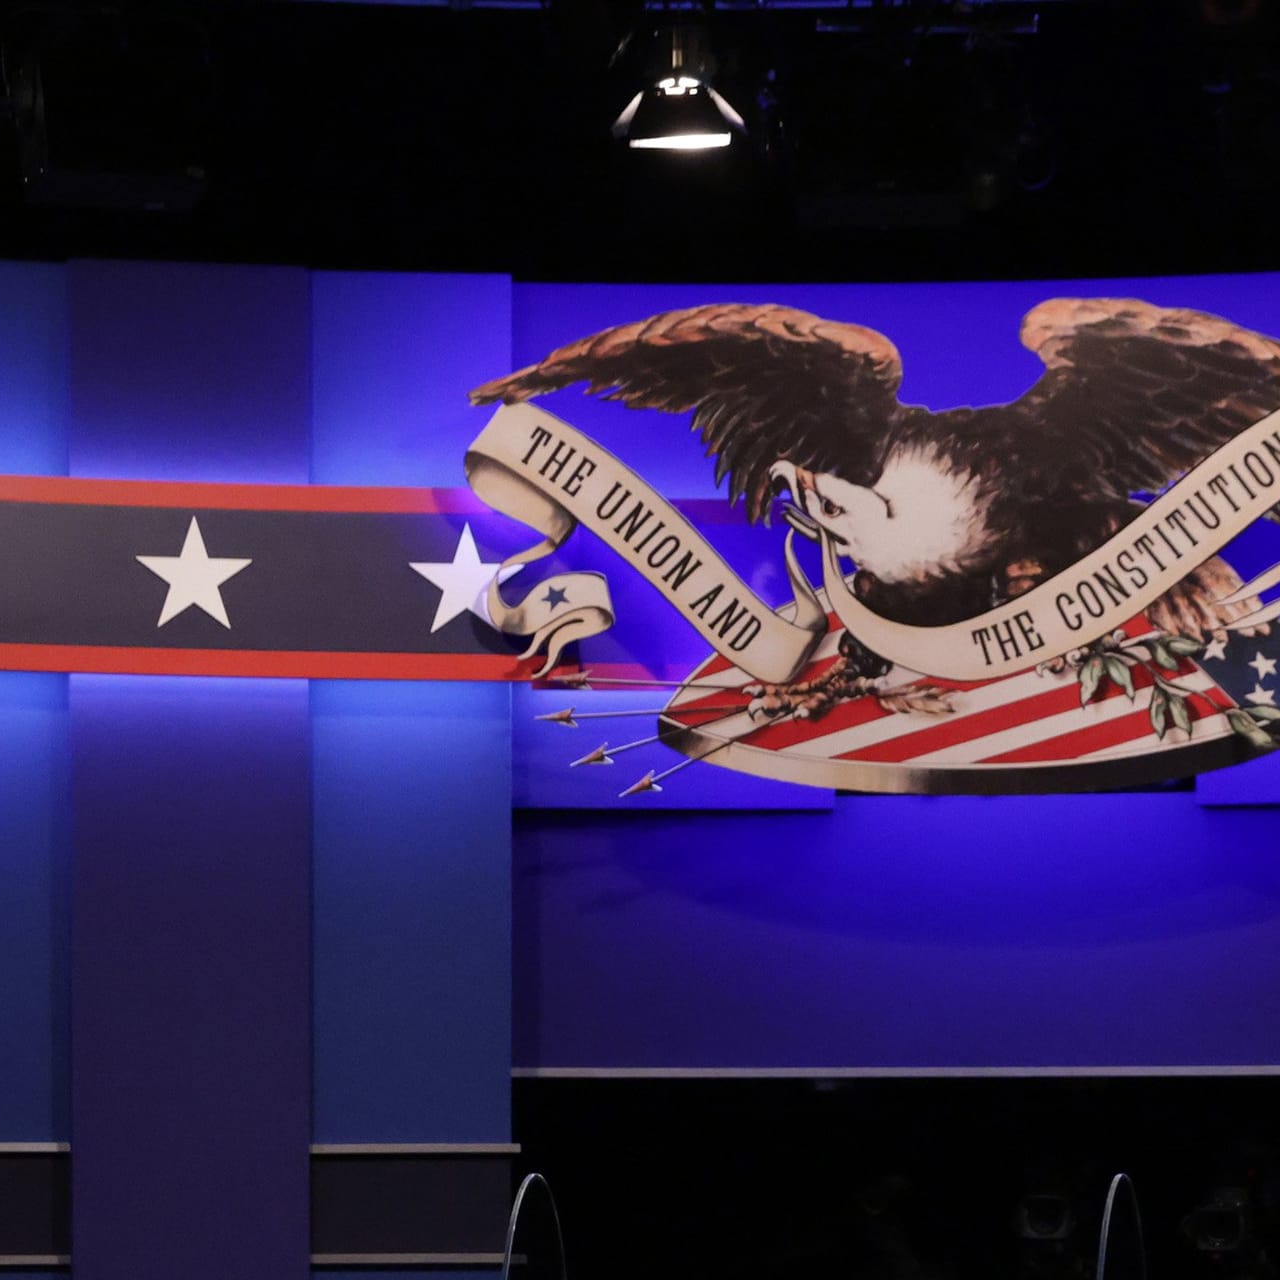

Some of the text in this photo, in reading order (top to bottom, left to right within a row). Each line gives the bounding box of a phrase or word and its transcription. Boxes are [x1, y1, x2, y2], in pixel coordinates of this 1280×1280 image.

[521, 425, 762, 652] THE UNION AND
[972, 611, 1044, 667] THE
